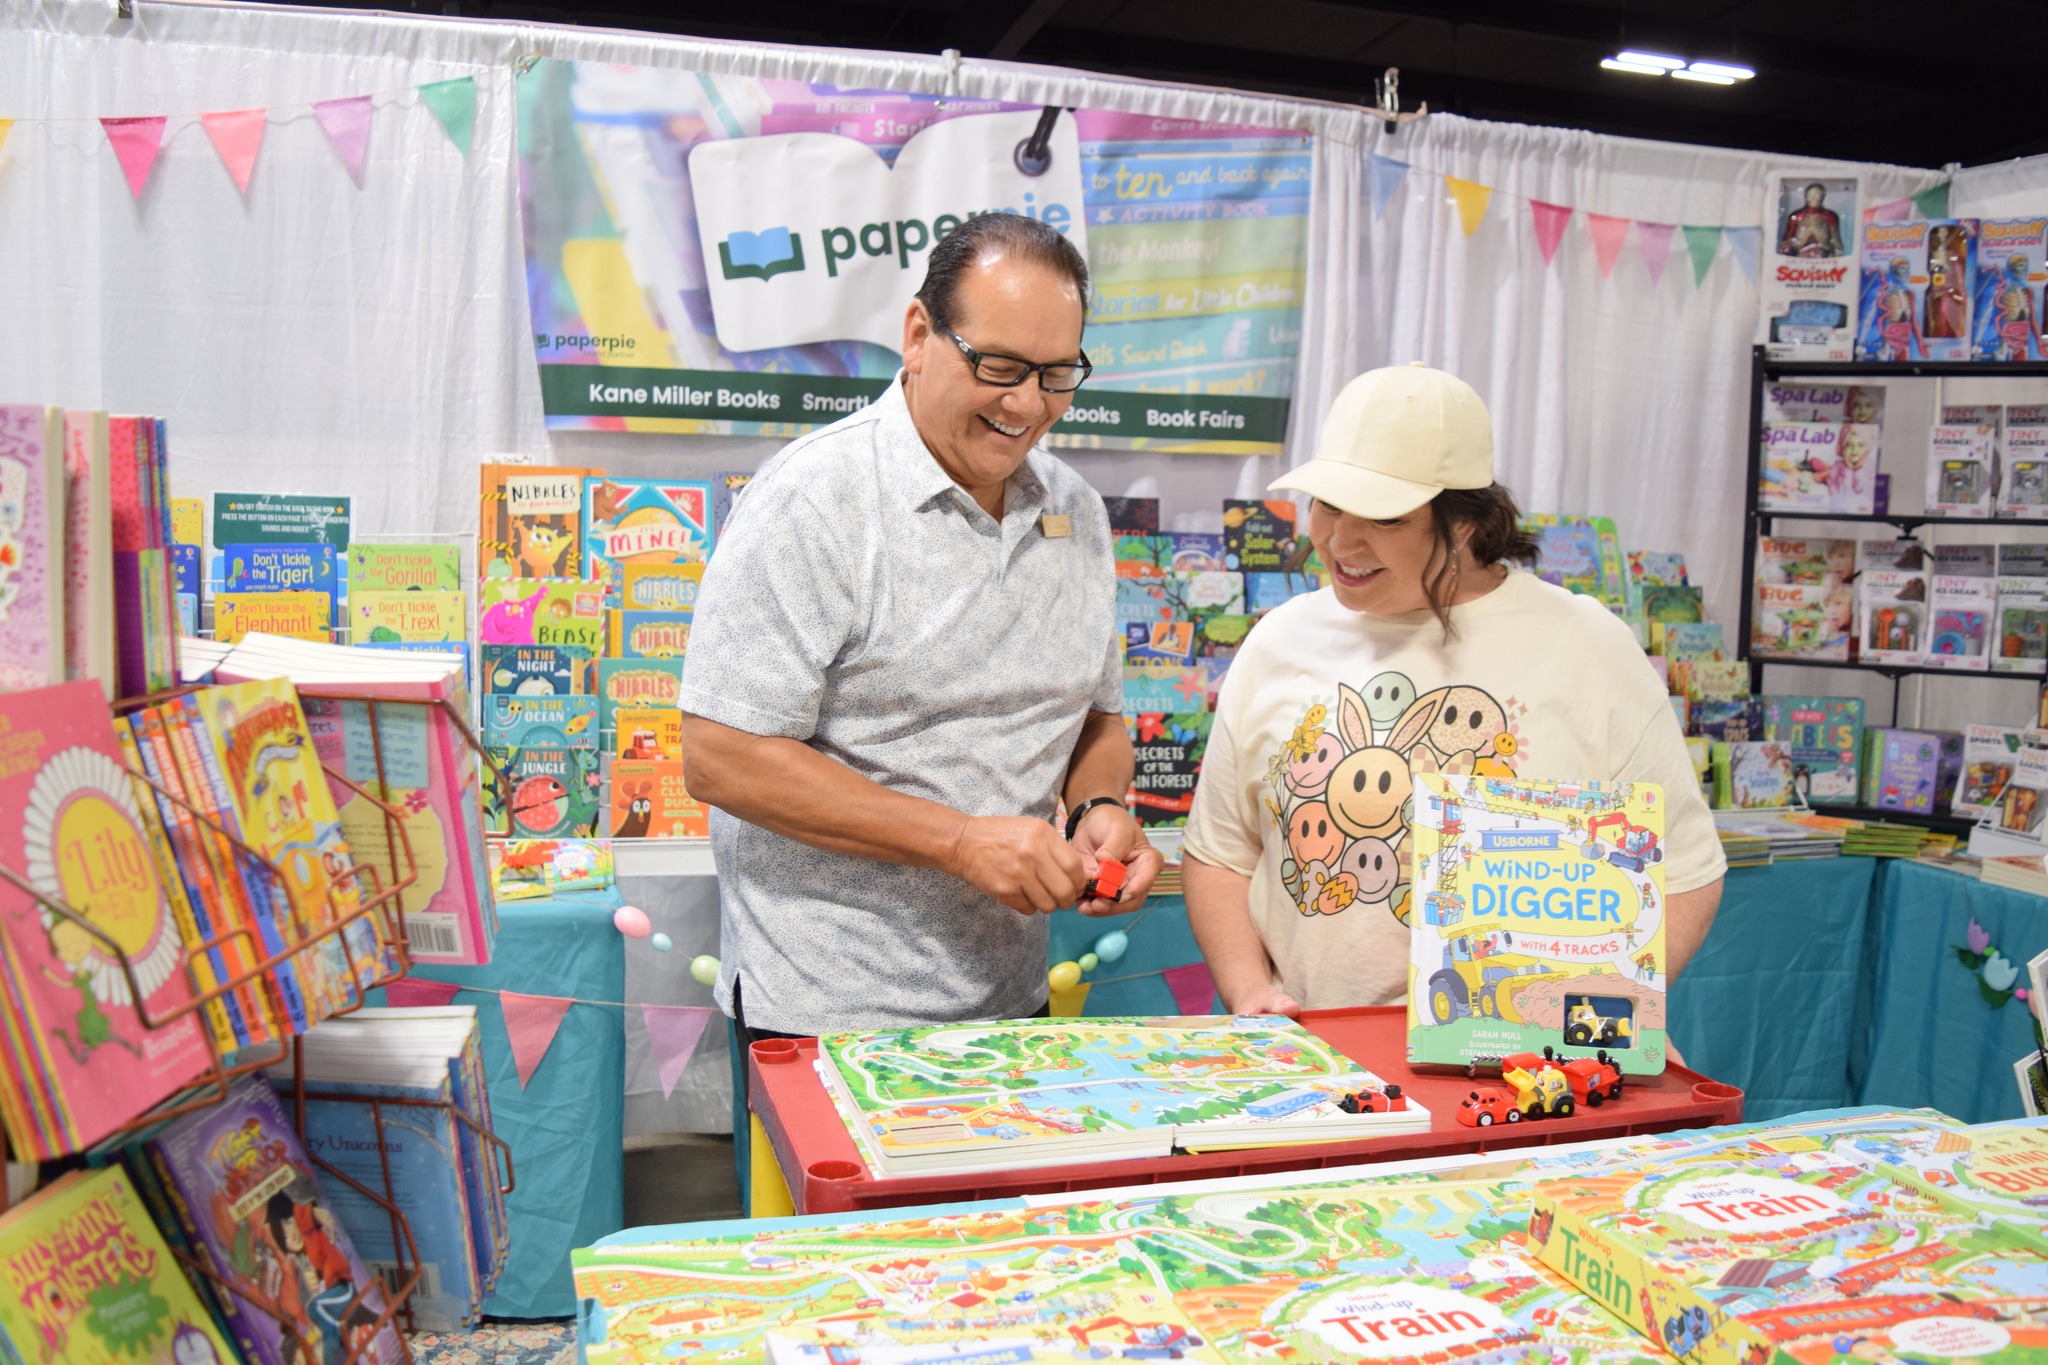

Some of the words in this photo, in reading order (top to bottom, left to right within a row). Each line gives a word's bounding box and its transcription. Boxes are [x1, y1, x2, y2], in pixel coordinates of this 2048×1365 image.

[1115, 164, 1173, 199] ten
[1176, 168, 1212, 184] and
[1218, 165, 1258, 183] back
[1120, 203, 1215, 222] ACTIVITY
[1223, 202, 1268, 217] BOOK
[1100, 243, 1131, 265] the
[1138, 236, 1221, 264] Monkey!
[1165, 294, 1187, 311] for
[1191, 288, 1232, 312] Little
[555, 334, 635, 350] paperpie
[589, 383, 648, 405] Kane
[652, 385, 712, 407] Miller
[717, 389, 781, 410] Books
[1770, 386, 1807, 406] Spa
[1809, 387, 1844, 405] Lab
[1062, 405, 1121, 425] Books
[1147, 408, 1196, 427] Book
[1200, 409, 1245, 430] Fairs
[1944, 406, 1975, 418] TINY
[2009, 407, 2041, 418] TINY
[1761, 426, 1797, 445] Spa
[1799, 426, 1836, 445] Lab
[1933, 428, 1967, 439] TINY
[2009, 429, 2041, 440] TINY
[512, 484, 576, 502] NIBBLES
[283, 504, 291, 512] THE
[248, 513, 266, 521] BUTTON
[261, 524, 280, 532] SOUNDS
[610, 531, 687, 555] MINE!
[1244, 533, 1276, 549] Solar
[1762, 539, 1806, 554] BUG
[253, 553, 278, 566] Don't
[282, 553, 311, 566] tickle
[376, 553, 401, 566] Don't
[405, 554, 433, 566] tickle
[1240, 549, 1280, 566] System
[252, 569, 266, 579] the
[267, 566, 314, 587] Tiger!
[370, 568, 384, 577] the
[385, 566, 437, 585] Gorilla!
[1937, 577, 1968, 587] TINY
[640, 581, 695, 601] NIBBLES
[1760, 586, 1804, 601] BUG
[240, 603, 262, 613] Don't
[265, 603, 290, 613] tickle
[293, 603, 306, 613] the
[379, 601, 403, 613] Don't
[408, 601, 436, 613] tickle
[235, 615, 312, 633] Elephant!
[539, 624, 599, 645] BEAST
[638, 630, 690, 650] NIBBLE
[517, 650, 531, 660] IN
[534, 649, 555, 660] THE
[517, 661, 556, 673] NIGHT
[616, 678, 674, 698] NIBBLES
[525, 700, 537, 711] IN
[540, 700, 563, 711] THE
[1123, 697, 1174, 712] SECRETS
[524, 710, 564, 723] OCEAN
[525, 751, 537, 762] IN
[540, 751, 564, 762] THE
[1135, 747, 1184, 761] SECRETS
[521, 762, 567, 775] JUNGLE
[1143, 763, 1157, 773] OF
[1159, 762, 1173, 772] THE
[660, 775, 685, 786] CLU
[1152, 774, 1193, 788] FOREST
[660, 787, 688, 797] CLU
[664, 798, 698, 807] DUCK
[1493, 834, 1550, 848] USBORNE
[65, 827, 148, 895] Lily
[1472, 883, 1621, 924] DIGGER
[1549, 940, 1561, 955] 4
[1564, 940, 1619, 955] TRACKS
[1472, 1030, 1498, 1038] SARAH
[1502, 1031, 1521, 1040] HULL
[326, 1135, 404, 1153] Unicons
[1984, 1150, 2048, 1166] WiND
[1691, 1181, 1730, 1190] Usborne
[1685, 1187, 1755, 1200] Wind-up
[1678, 1193, 1830, 1223] Train
[67, 1195, 125, 1254] MINI
[1579, 1226, 1612, 1259] Wind-up
[20, 1224, 158, 1328] MONSTERS
[1560, 1226, 1632, 1316] Train
[1346, 1292, 1390, 1301] Usborne
[1335, 1299, 1413, 1314] Wind-up
[1320, 1308, 1487, 1344] Train
